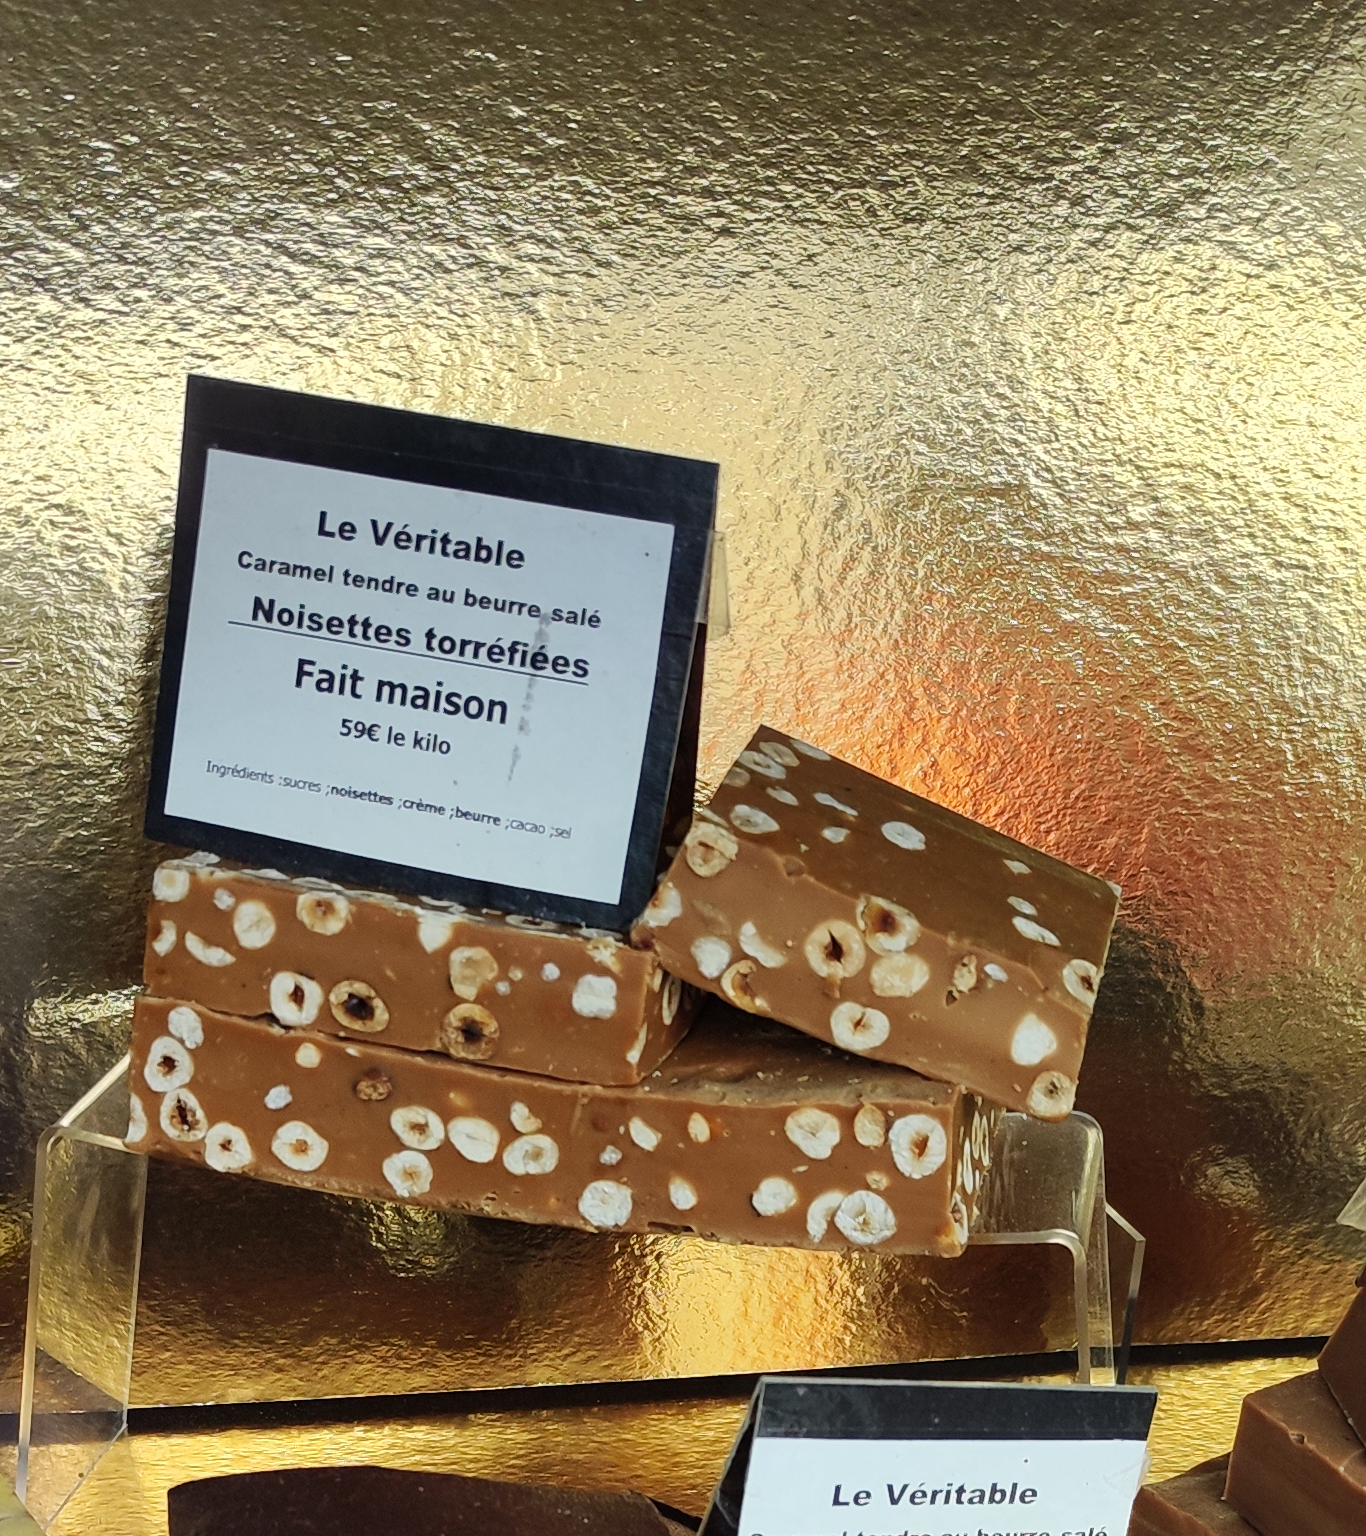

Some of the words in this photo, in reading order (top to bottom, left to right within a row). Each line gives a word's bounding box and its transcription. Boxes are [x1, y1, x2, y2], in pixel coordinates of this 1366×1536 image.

[318, 511, 357, 541] Le
[369, 519, 526, 570] Véritable
[237, 550, 334, 584] Caramel
[342, 570, 419, 598] tendre
[426, 583, 455, 604] au
[464, 589, 542, 619] beurre
[550, 601, 602, 629] salé
[251, 597, 412, 648] Noisettes
[423, 627, 590, 679] torréfiées
[294, 659, 364, 699] Fait
[375, 678, 508, 725] maison
[339, 719, 381, 742] 59€
[387, 725, 406, 748] le
[412, 731, 452, 755] kilo
[206, 760, 275, 784] Ingrédients
[832, 1485, 872, 1507] Le
[886, 1482, 1039, 1506] Véritable
